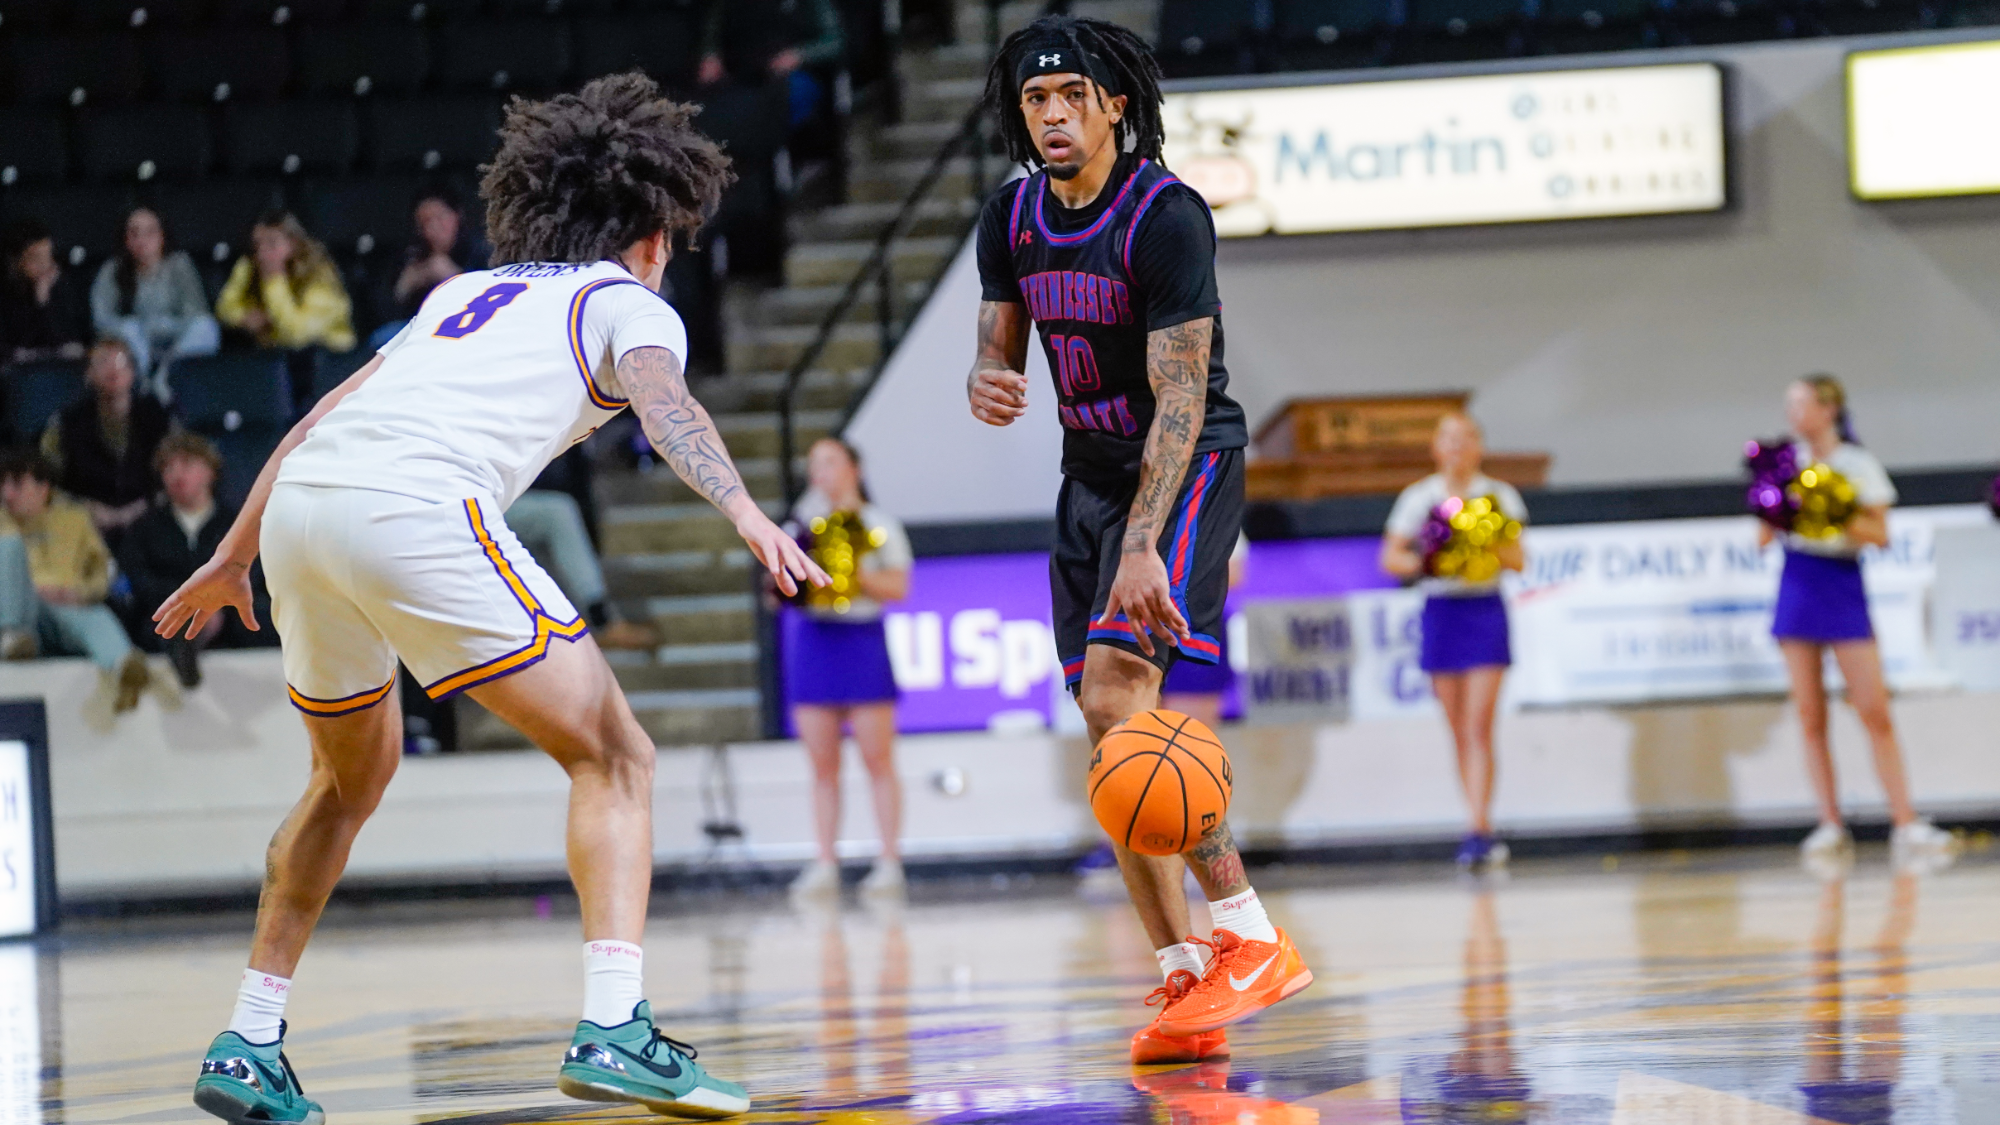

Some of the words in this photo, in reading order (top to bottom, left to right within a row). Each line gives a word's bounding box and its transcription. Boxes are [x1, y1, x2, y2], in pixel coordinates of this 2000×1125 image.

[1275, 118, 1506, 183] Martin
[431, 282, 531, 340] 8
[1050, 334, 1101, 397] 10
[1059, 394, 1138, 436] ATE
[1601, 541, 1714, 583] DAILY
